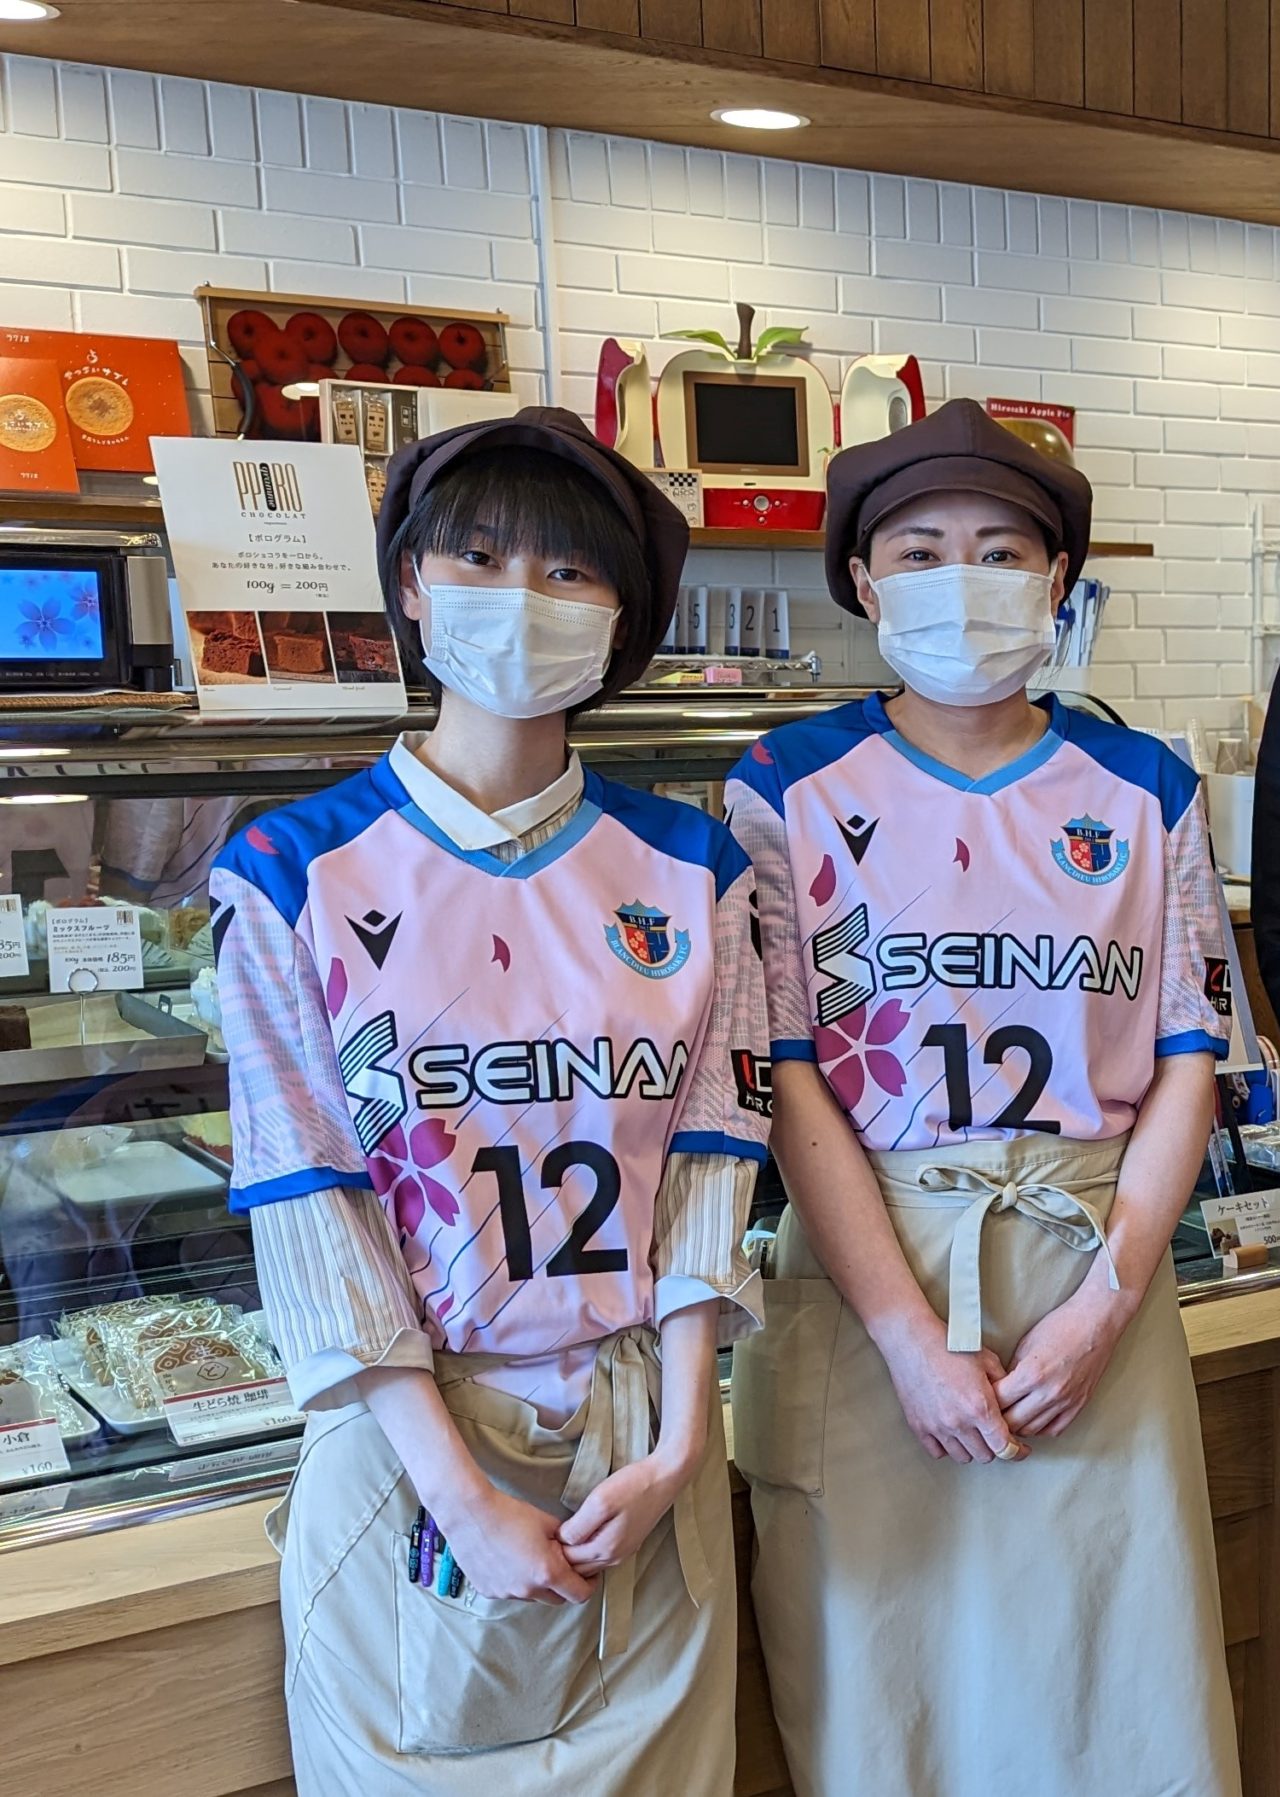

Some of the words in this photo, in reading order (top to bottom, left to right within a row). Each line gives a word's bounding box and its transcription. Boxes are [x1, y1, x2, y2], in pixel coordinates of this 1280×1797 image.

[991, 403, 1027, 414] Hirosaki
[1030, 407, 1055, 417] Apple
[1057, 409, 1070, 418] Pie
[241, 511, 306, 520] CHOCOLAT
[729, 604, 735, 629] 3
[745, 606, 754, 631] 2
[773, 607, 780, 632] 1
[876, 932, 1143, 1001] SEINAN
[920, 1023, 1061, 1135] 12
[470, 1140, 629, 1282] 12
[1217, 1198, 1269, 1216] ケーキセット
[3, 1431, 30, 1445] 小倉
